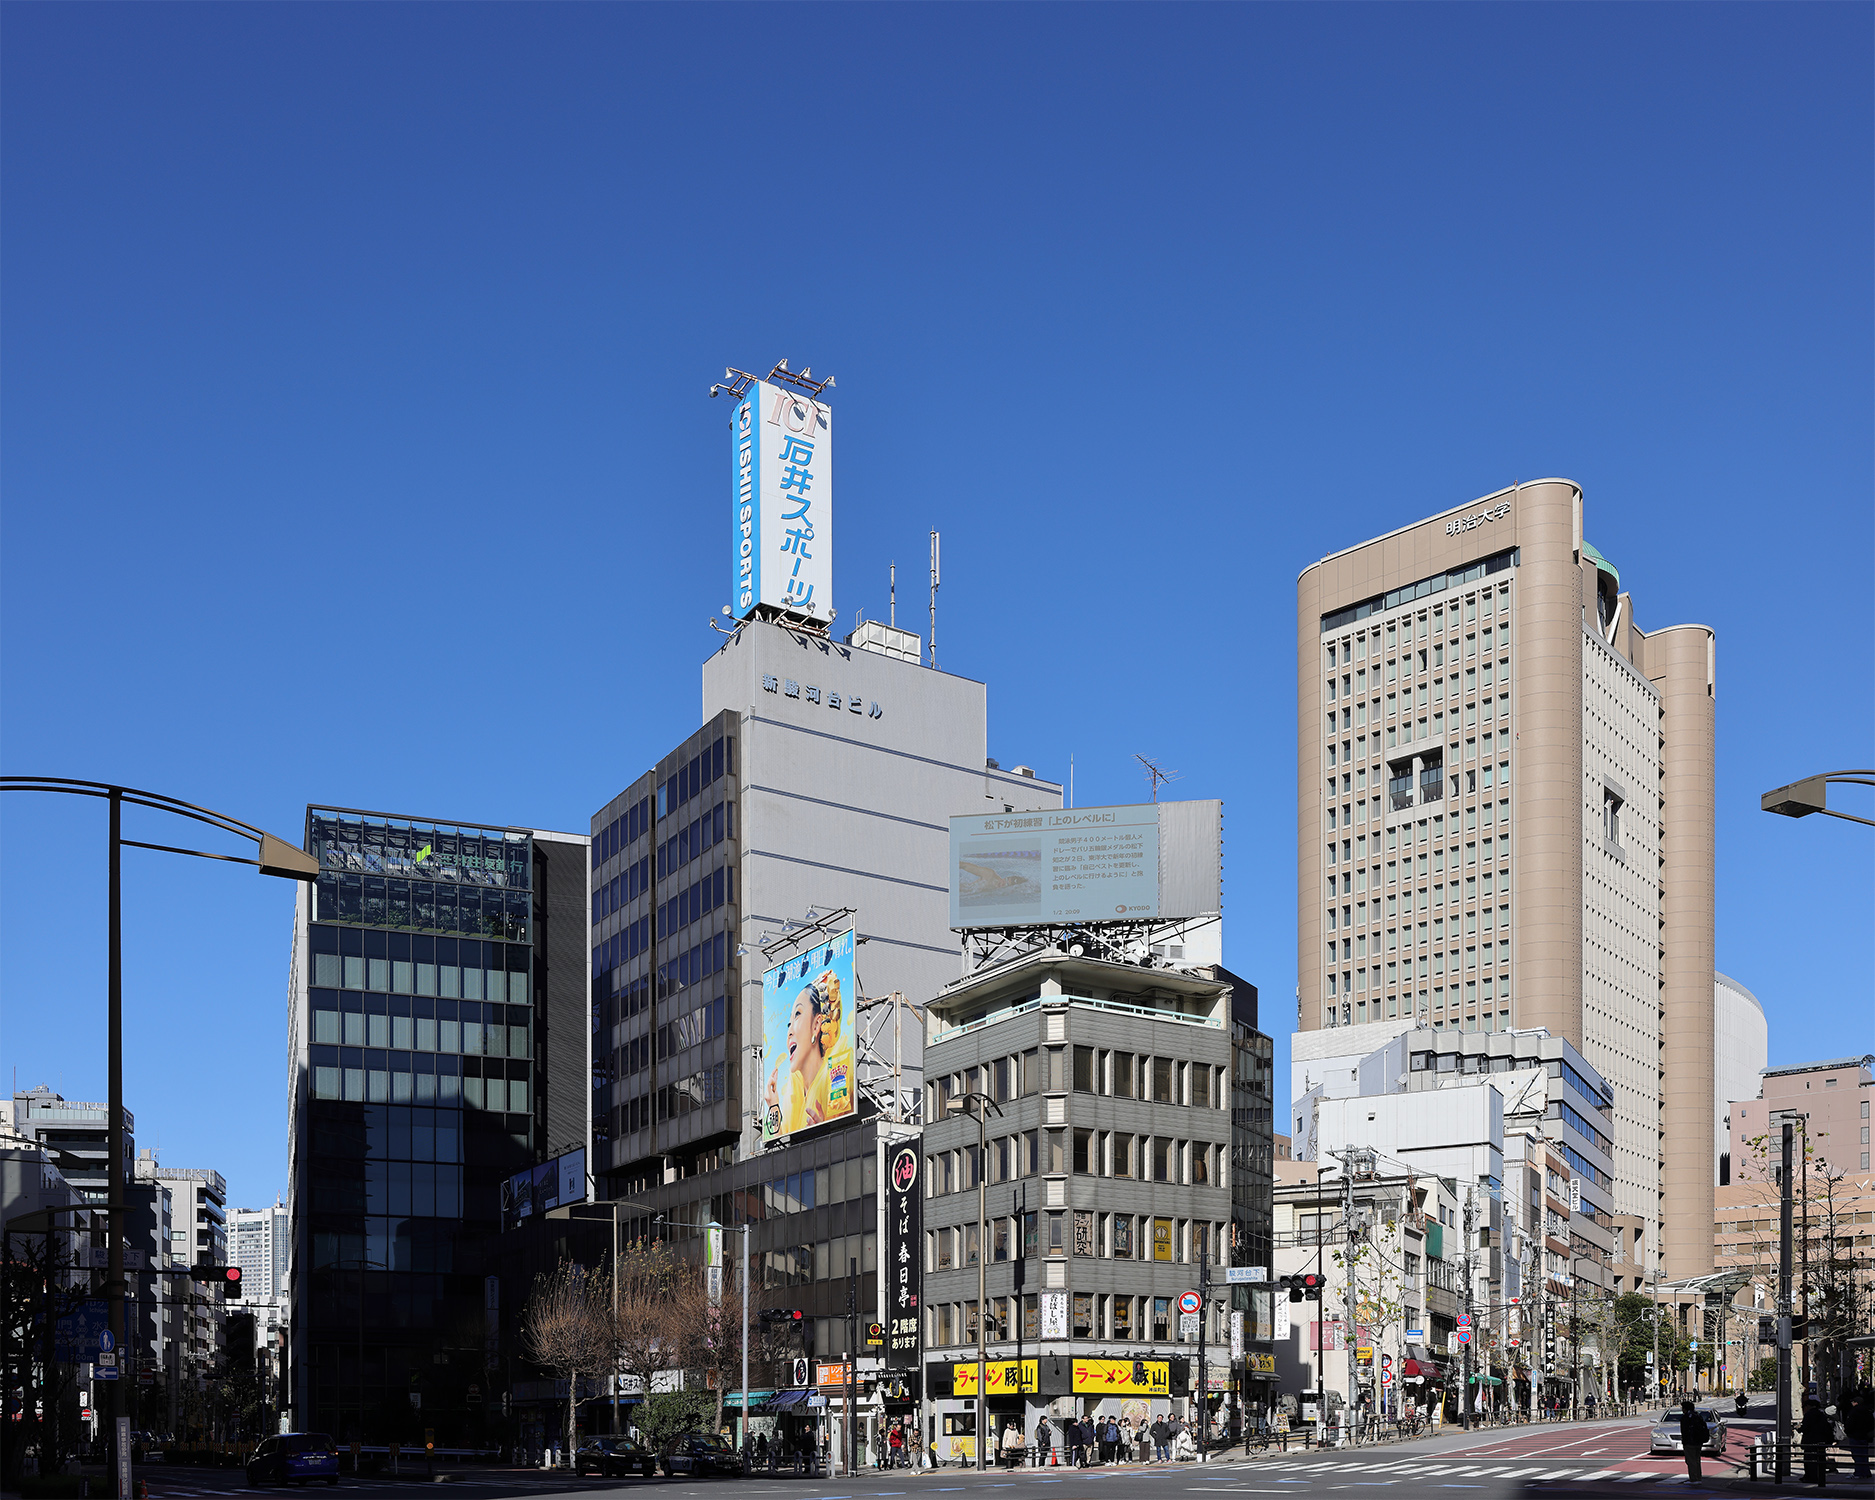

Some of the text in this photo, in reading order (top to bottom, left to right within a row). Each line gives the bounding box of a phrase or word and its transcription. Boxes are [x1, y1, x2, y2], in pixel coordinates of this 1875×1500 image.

[738, 401, 753, 609] ICI ISHII SPORTS
[1446, 500, 1511, 537] 明治大学
[778, 434, 815, 608] 石井スポーツ
[762, 673, 883, 720] 新駿河台ビル
[984, 812, 1117, 830] 松下が初練習「上のレベルに」
[895, 1156, 914, 1186] 油
[1076, 1226, 1088, 1255] 研究
[1229, 1268, 1260, 1277] 駿河台下
[891, 1318, 918, 1335] 2階席
[891, 1335, 917, 1350] あります
